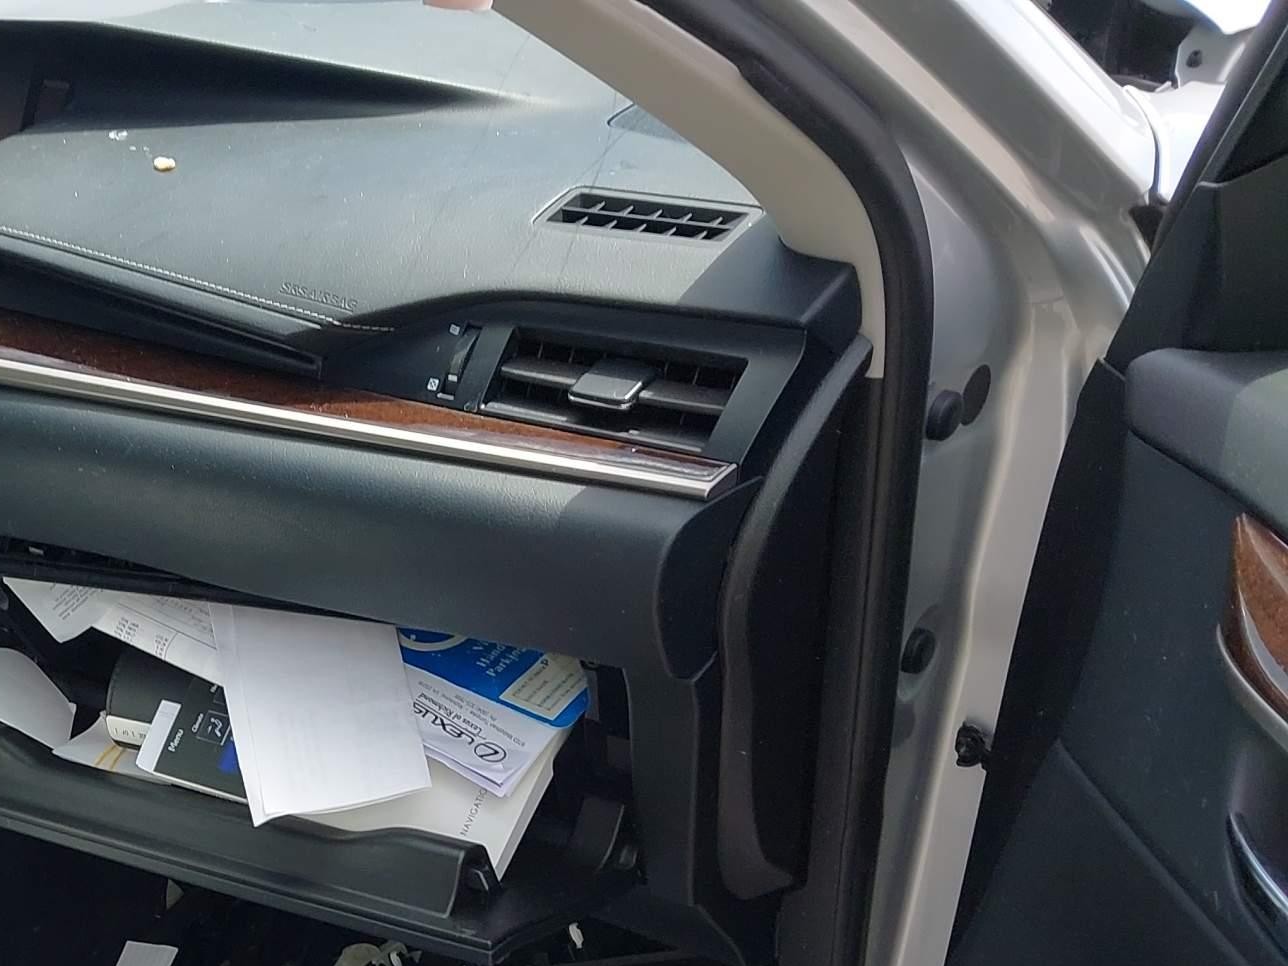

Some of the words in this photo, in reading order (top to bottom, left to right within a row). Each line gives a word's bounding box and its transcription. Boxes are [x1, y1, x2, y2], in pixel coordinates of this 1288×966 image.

[420, 692, 451, 719] Richmond
[451, 711, 462, 723] of
[413, 701, 475, 746] LEXUS
[463, 717, 483, 738] Lexus
[168, 728, 184, 752] Menu
